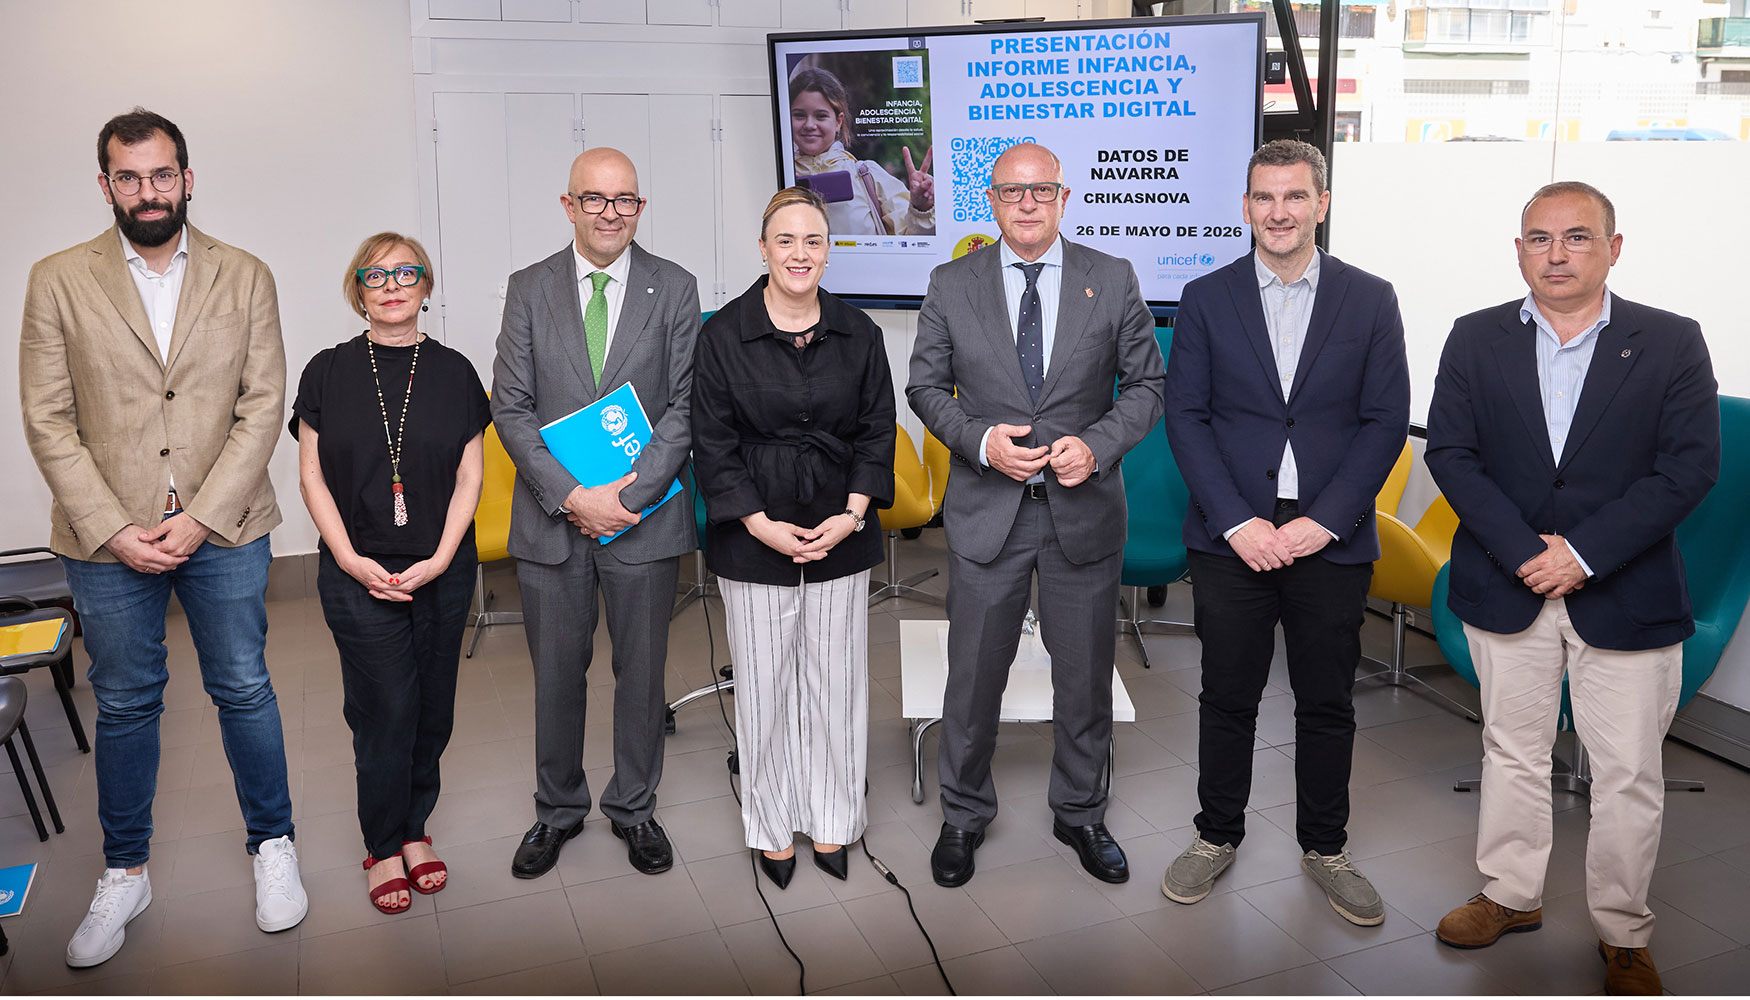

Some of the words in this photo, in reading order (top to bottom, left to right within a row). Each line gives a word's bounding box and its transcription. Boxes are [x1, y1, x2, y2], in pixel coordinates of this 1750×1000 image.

[990, 30, 1170, 54] PRESENTACIÓN
[967, 58, 1070, 77] INFORME
[1077, 54, 1197, 74] INFANCIA,
[980, 78, 1160, 99] ADOLESCENCIA
[1166, 77, 1183, 94] Y
[859, 108, 916, 116] ADOLESCENCIA
[968, 102, 1095, 121] BIENESTAR
[1103, 100, 1197, 118] DIGITAL
[1097, 149, 1158, 163] DATOS
[1164, 149, 1189, 162] DE
[1090, 167, 1179, 180] NAVARRA
[1083, 192, 1191, 204] CRIKASNOVA
[1076, 225, 1095, 236] 26
[1099, 225, 1121, 236] DE
[1125, 226, 1171, 237] MAYO
[1176, 226, 1198, 237] DE
[1202, 226, 1243, 238] 2026
[1157, 253, 1198, 266] unicef
